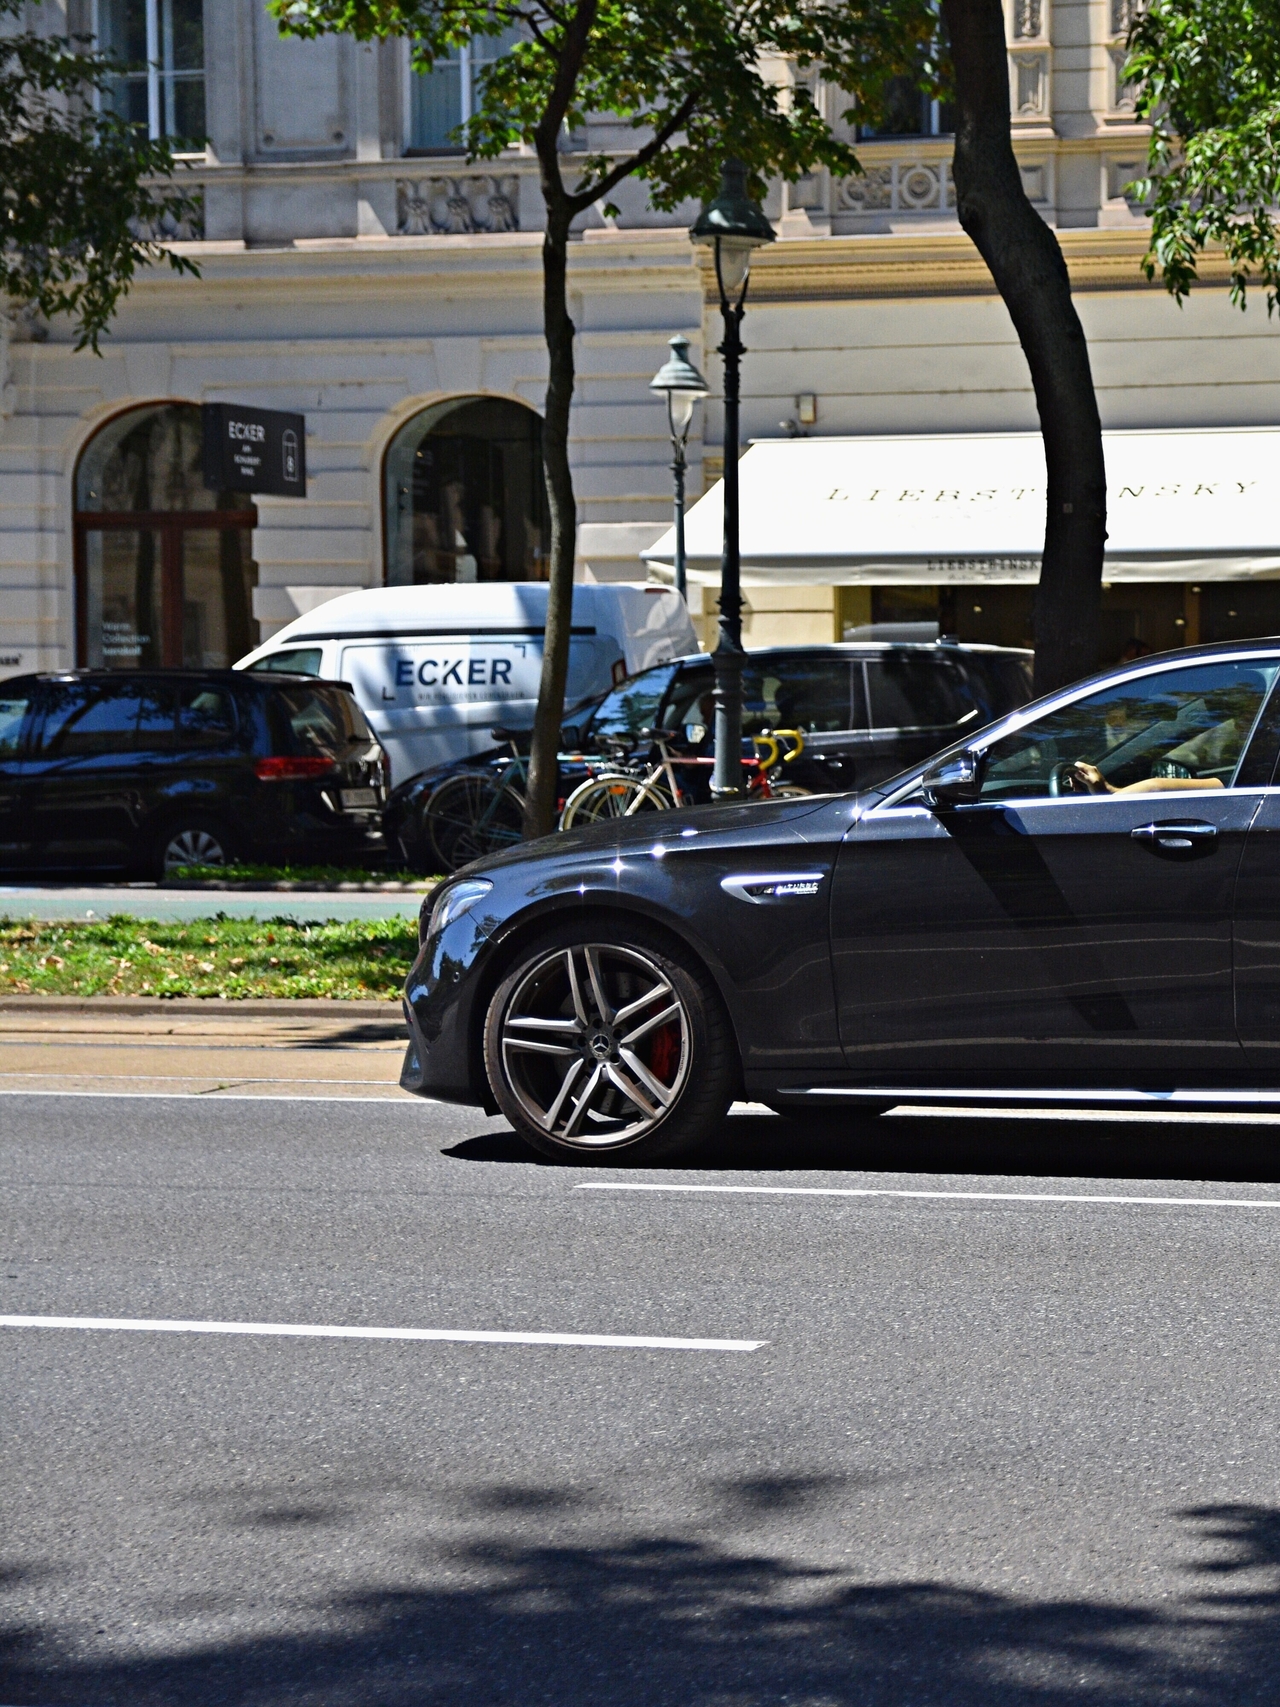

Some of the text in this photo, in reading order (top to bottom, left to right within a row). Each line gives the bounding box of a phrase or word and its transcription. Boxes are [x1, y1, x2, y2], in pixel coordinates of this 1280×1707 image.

[228, 421, 265, 442] ECKER
[823, 481, 1258, 501] LIEBSTNSKY
[927, 558, 1040, 571] LIEBSTEINSK
[396, 659, 512, 686] ECKER
